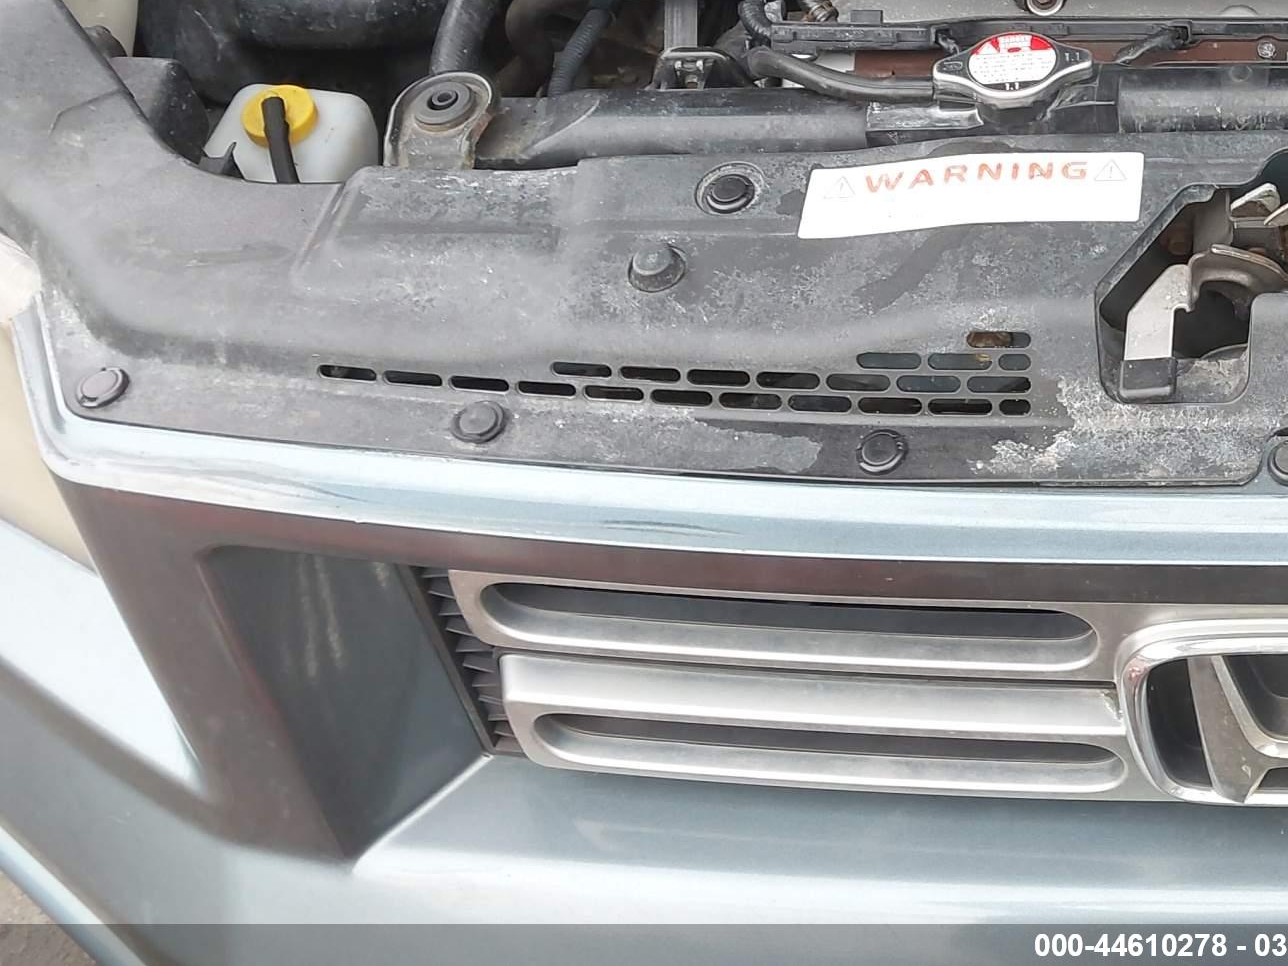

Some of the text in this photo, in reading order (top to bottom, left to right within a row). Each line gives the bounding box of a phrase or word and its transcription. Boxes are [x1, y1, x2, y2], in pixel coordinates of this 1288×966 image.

[1064, 52, 1080, 61] 1.1
[1005, 82, 1019, 91] 1.1
[865, 161, 1088, 193] WARNING
